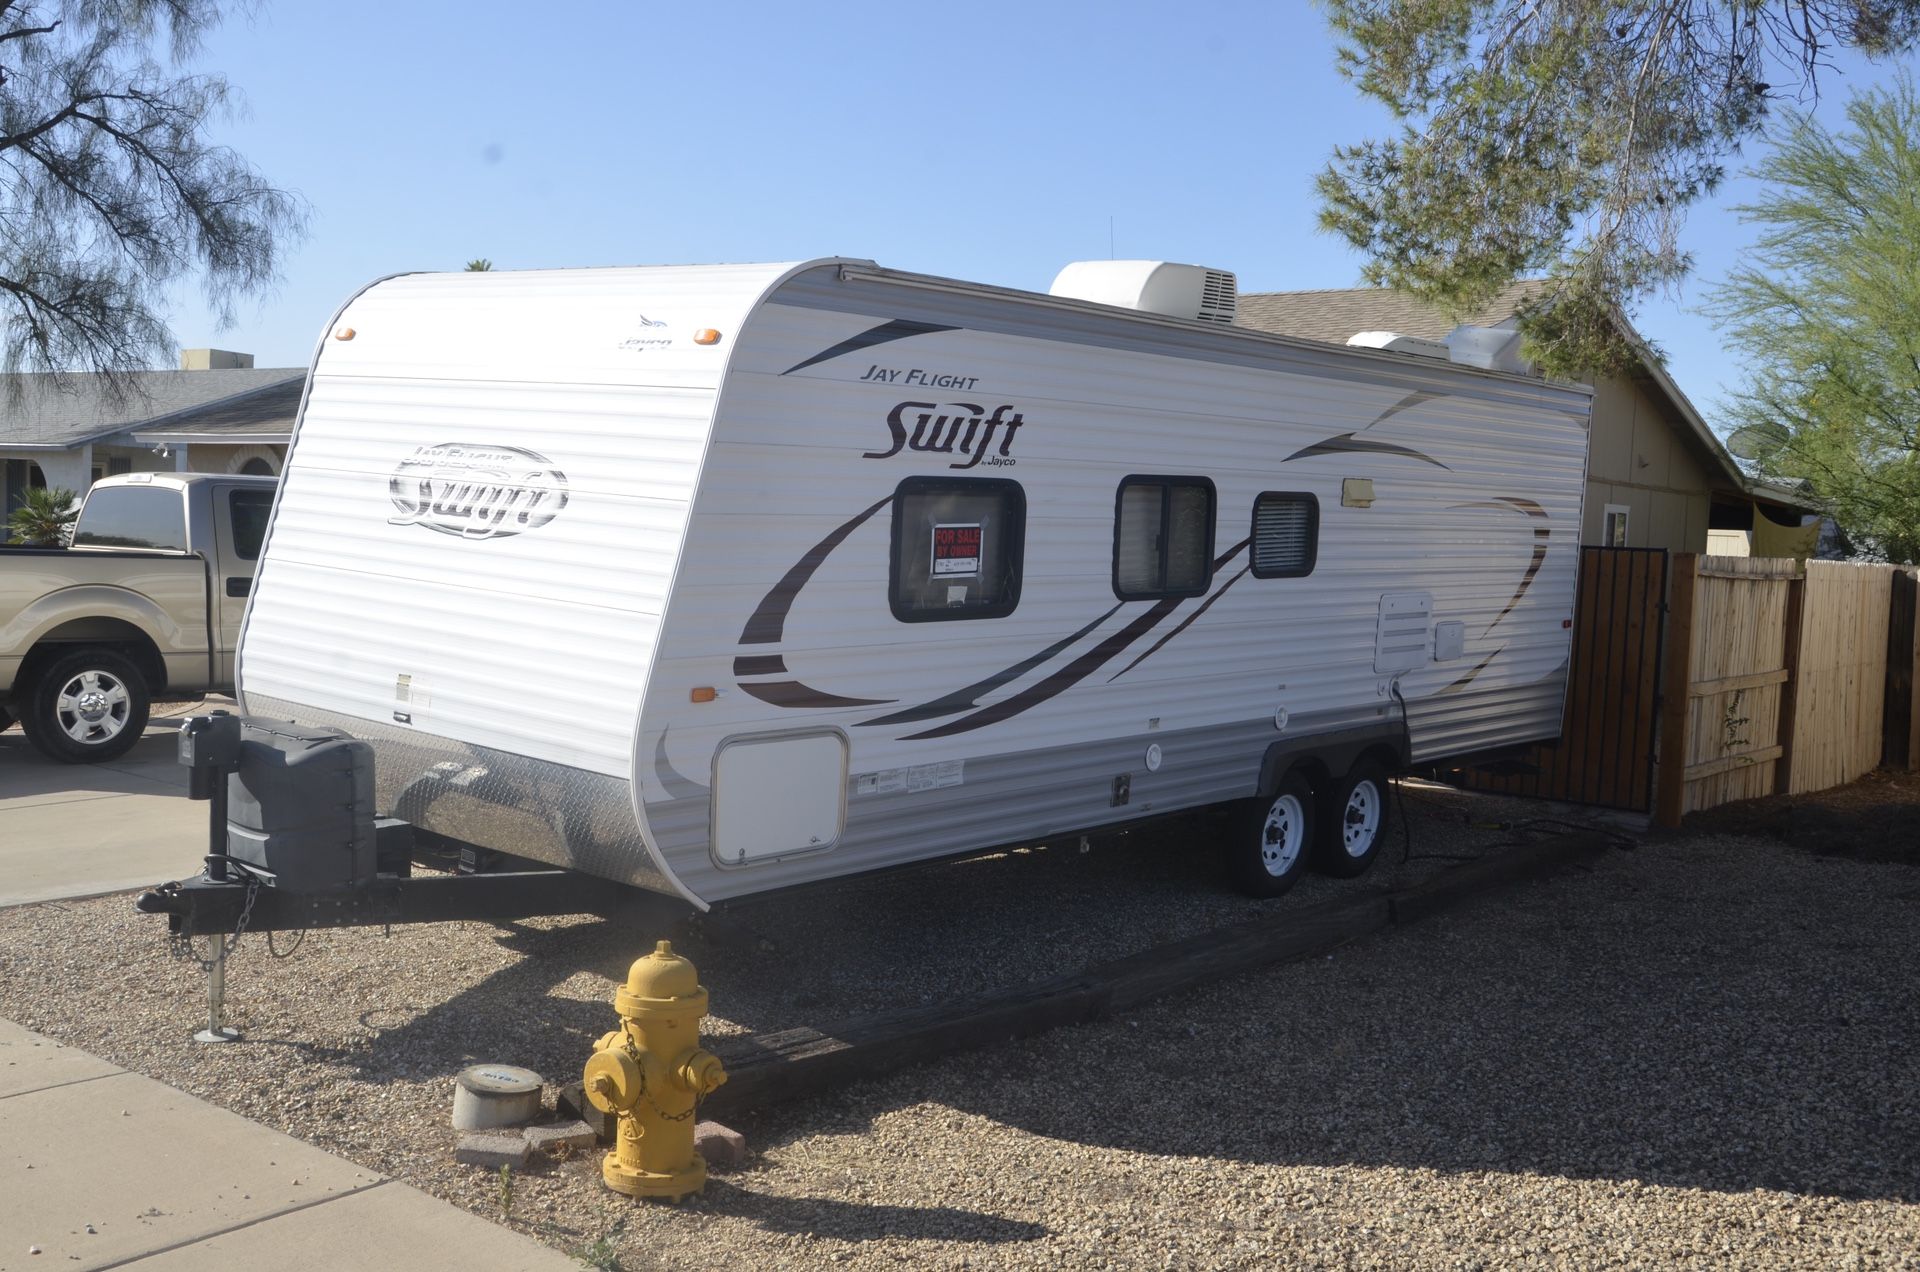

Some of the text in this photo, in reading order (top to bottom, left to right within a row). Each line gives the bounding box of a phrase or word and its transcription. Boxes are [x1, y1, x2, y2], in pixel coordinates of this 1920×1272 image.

[860, 364, 979, 390] JAY FLIGHT
[862, 401, 1024, 470] Swift
[987, 455, 1016, 468] Jayco
[936, 528, 980, 545] FOR SALE
[936, 544, 977, 557] BY OWNER
